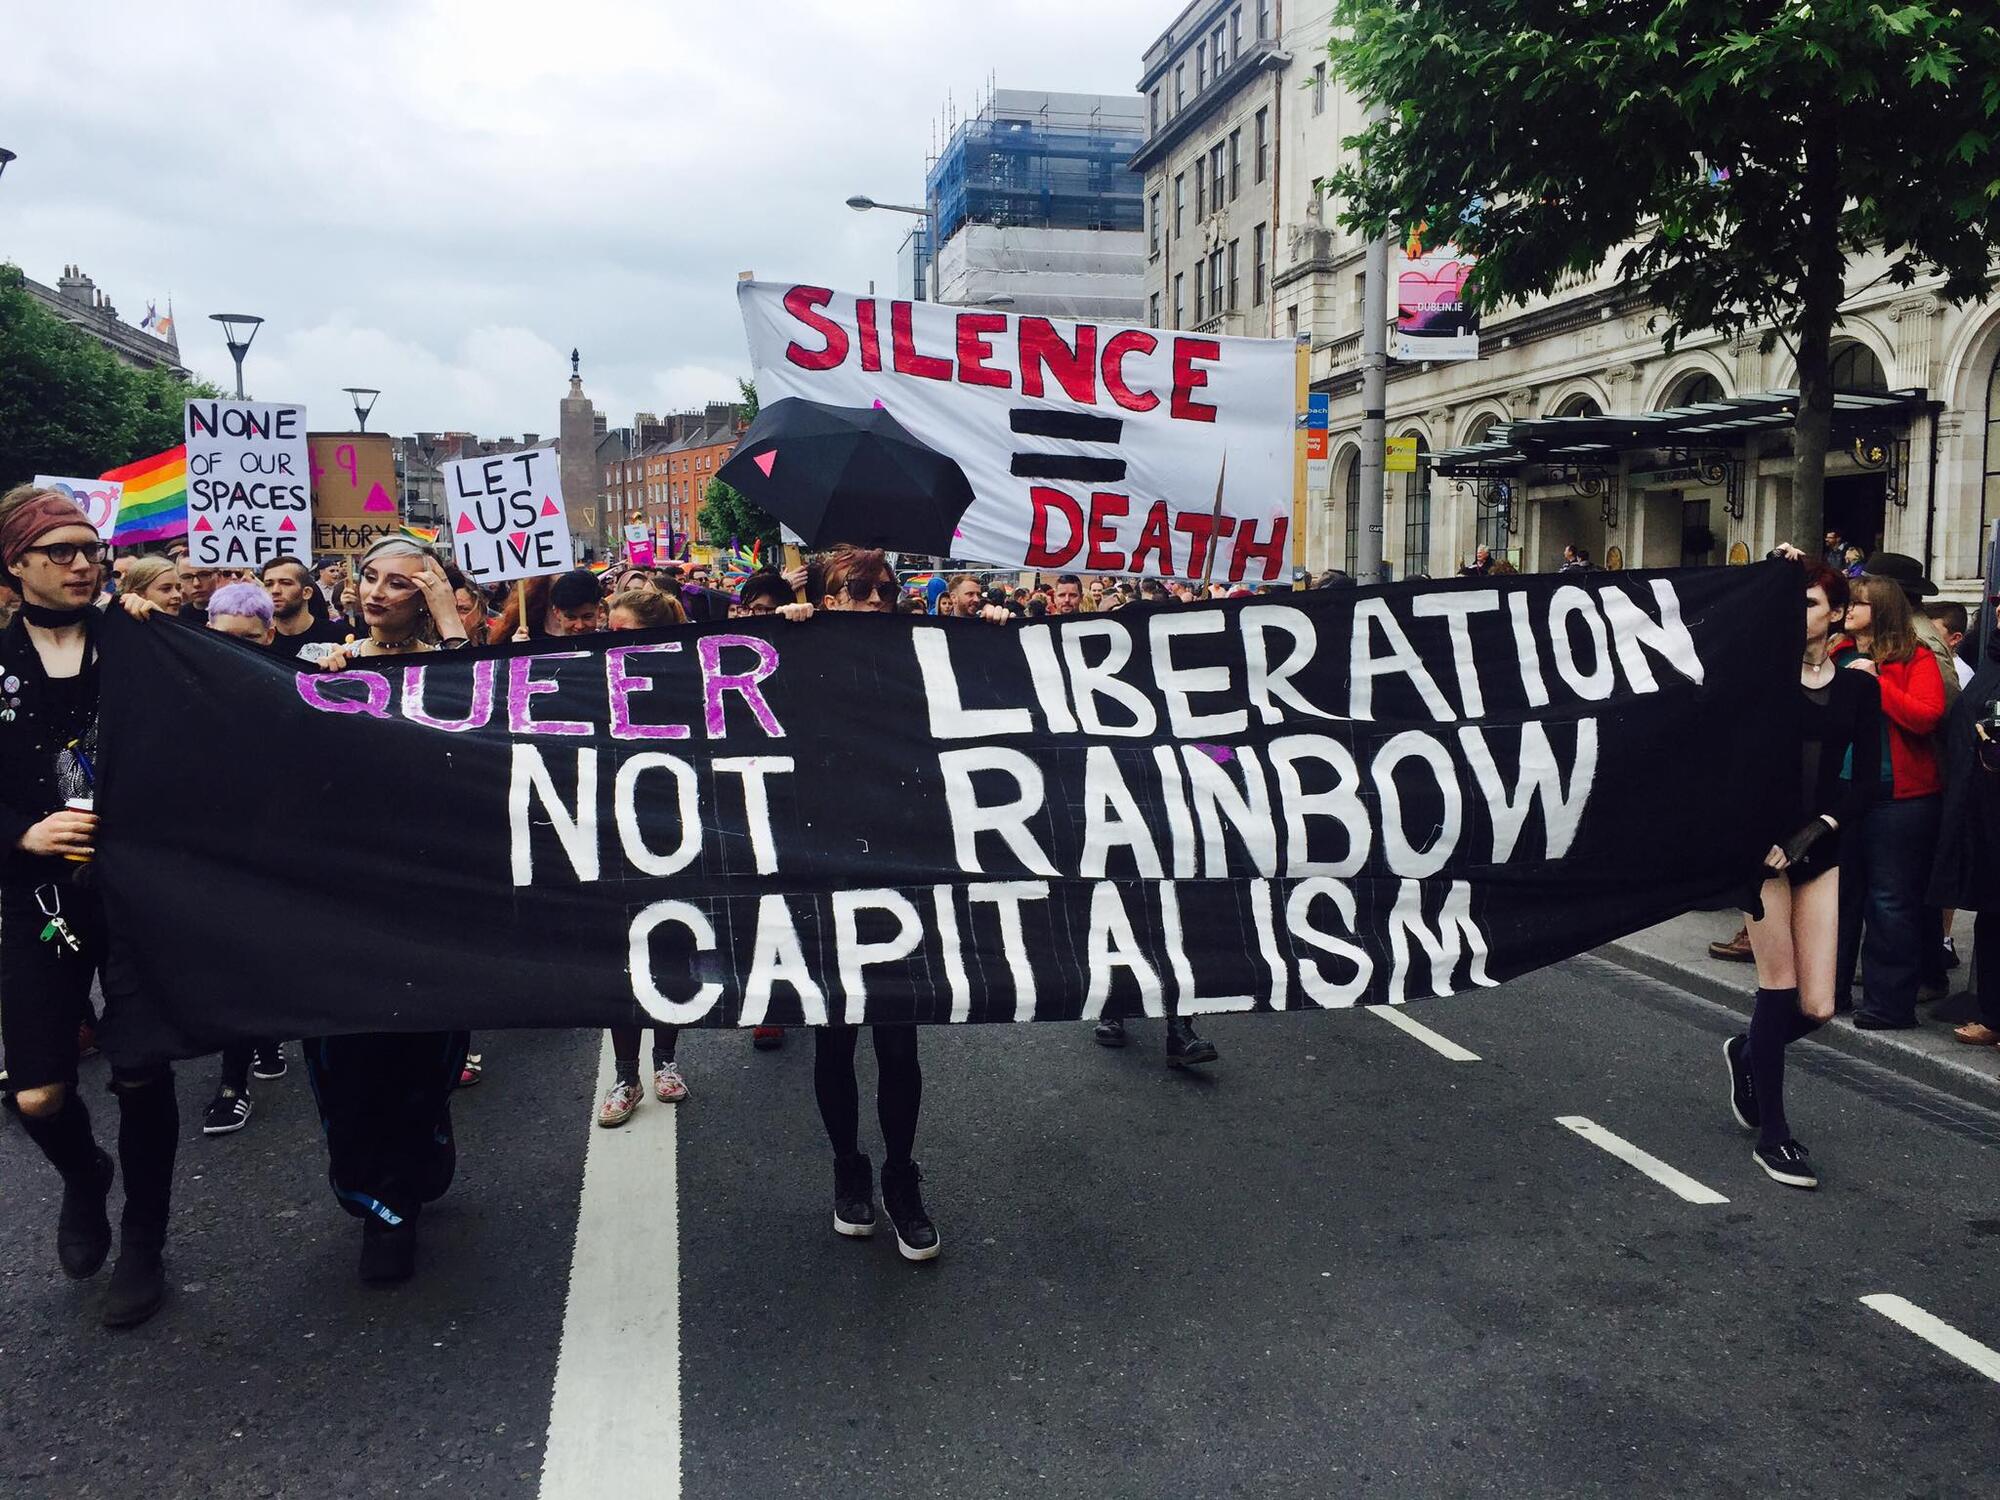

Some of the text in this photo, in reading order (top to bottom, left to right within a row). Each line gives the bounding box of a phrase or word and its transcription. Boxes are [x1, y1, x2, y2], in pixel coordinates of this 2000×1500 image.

[782, 284, 1221, 423] SILENCE
[189, 403, 297, 440] NONE
[190, 452, 295, 476] OF OUR
[456, 452, 539, 498] LET
[191, 479, 307, 513] SPACES
[475, 490, 537, 534] US
[222, 514, 266, 533] ARE
[1025, 487, 1289, 584] DEATH
[199, 535, 297, 564] SAFE
[464, 530, 562, 575] LIVE
[295, 578, 1705, 740] QUEER LIBERATION
[507, 716, 1599, 887] NOT RAINBOW
[628, 876, 1500, 1026] CAPITALISM
